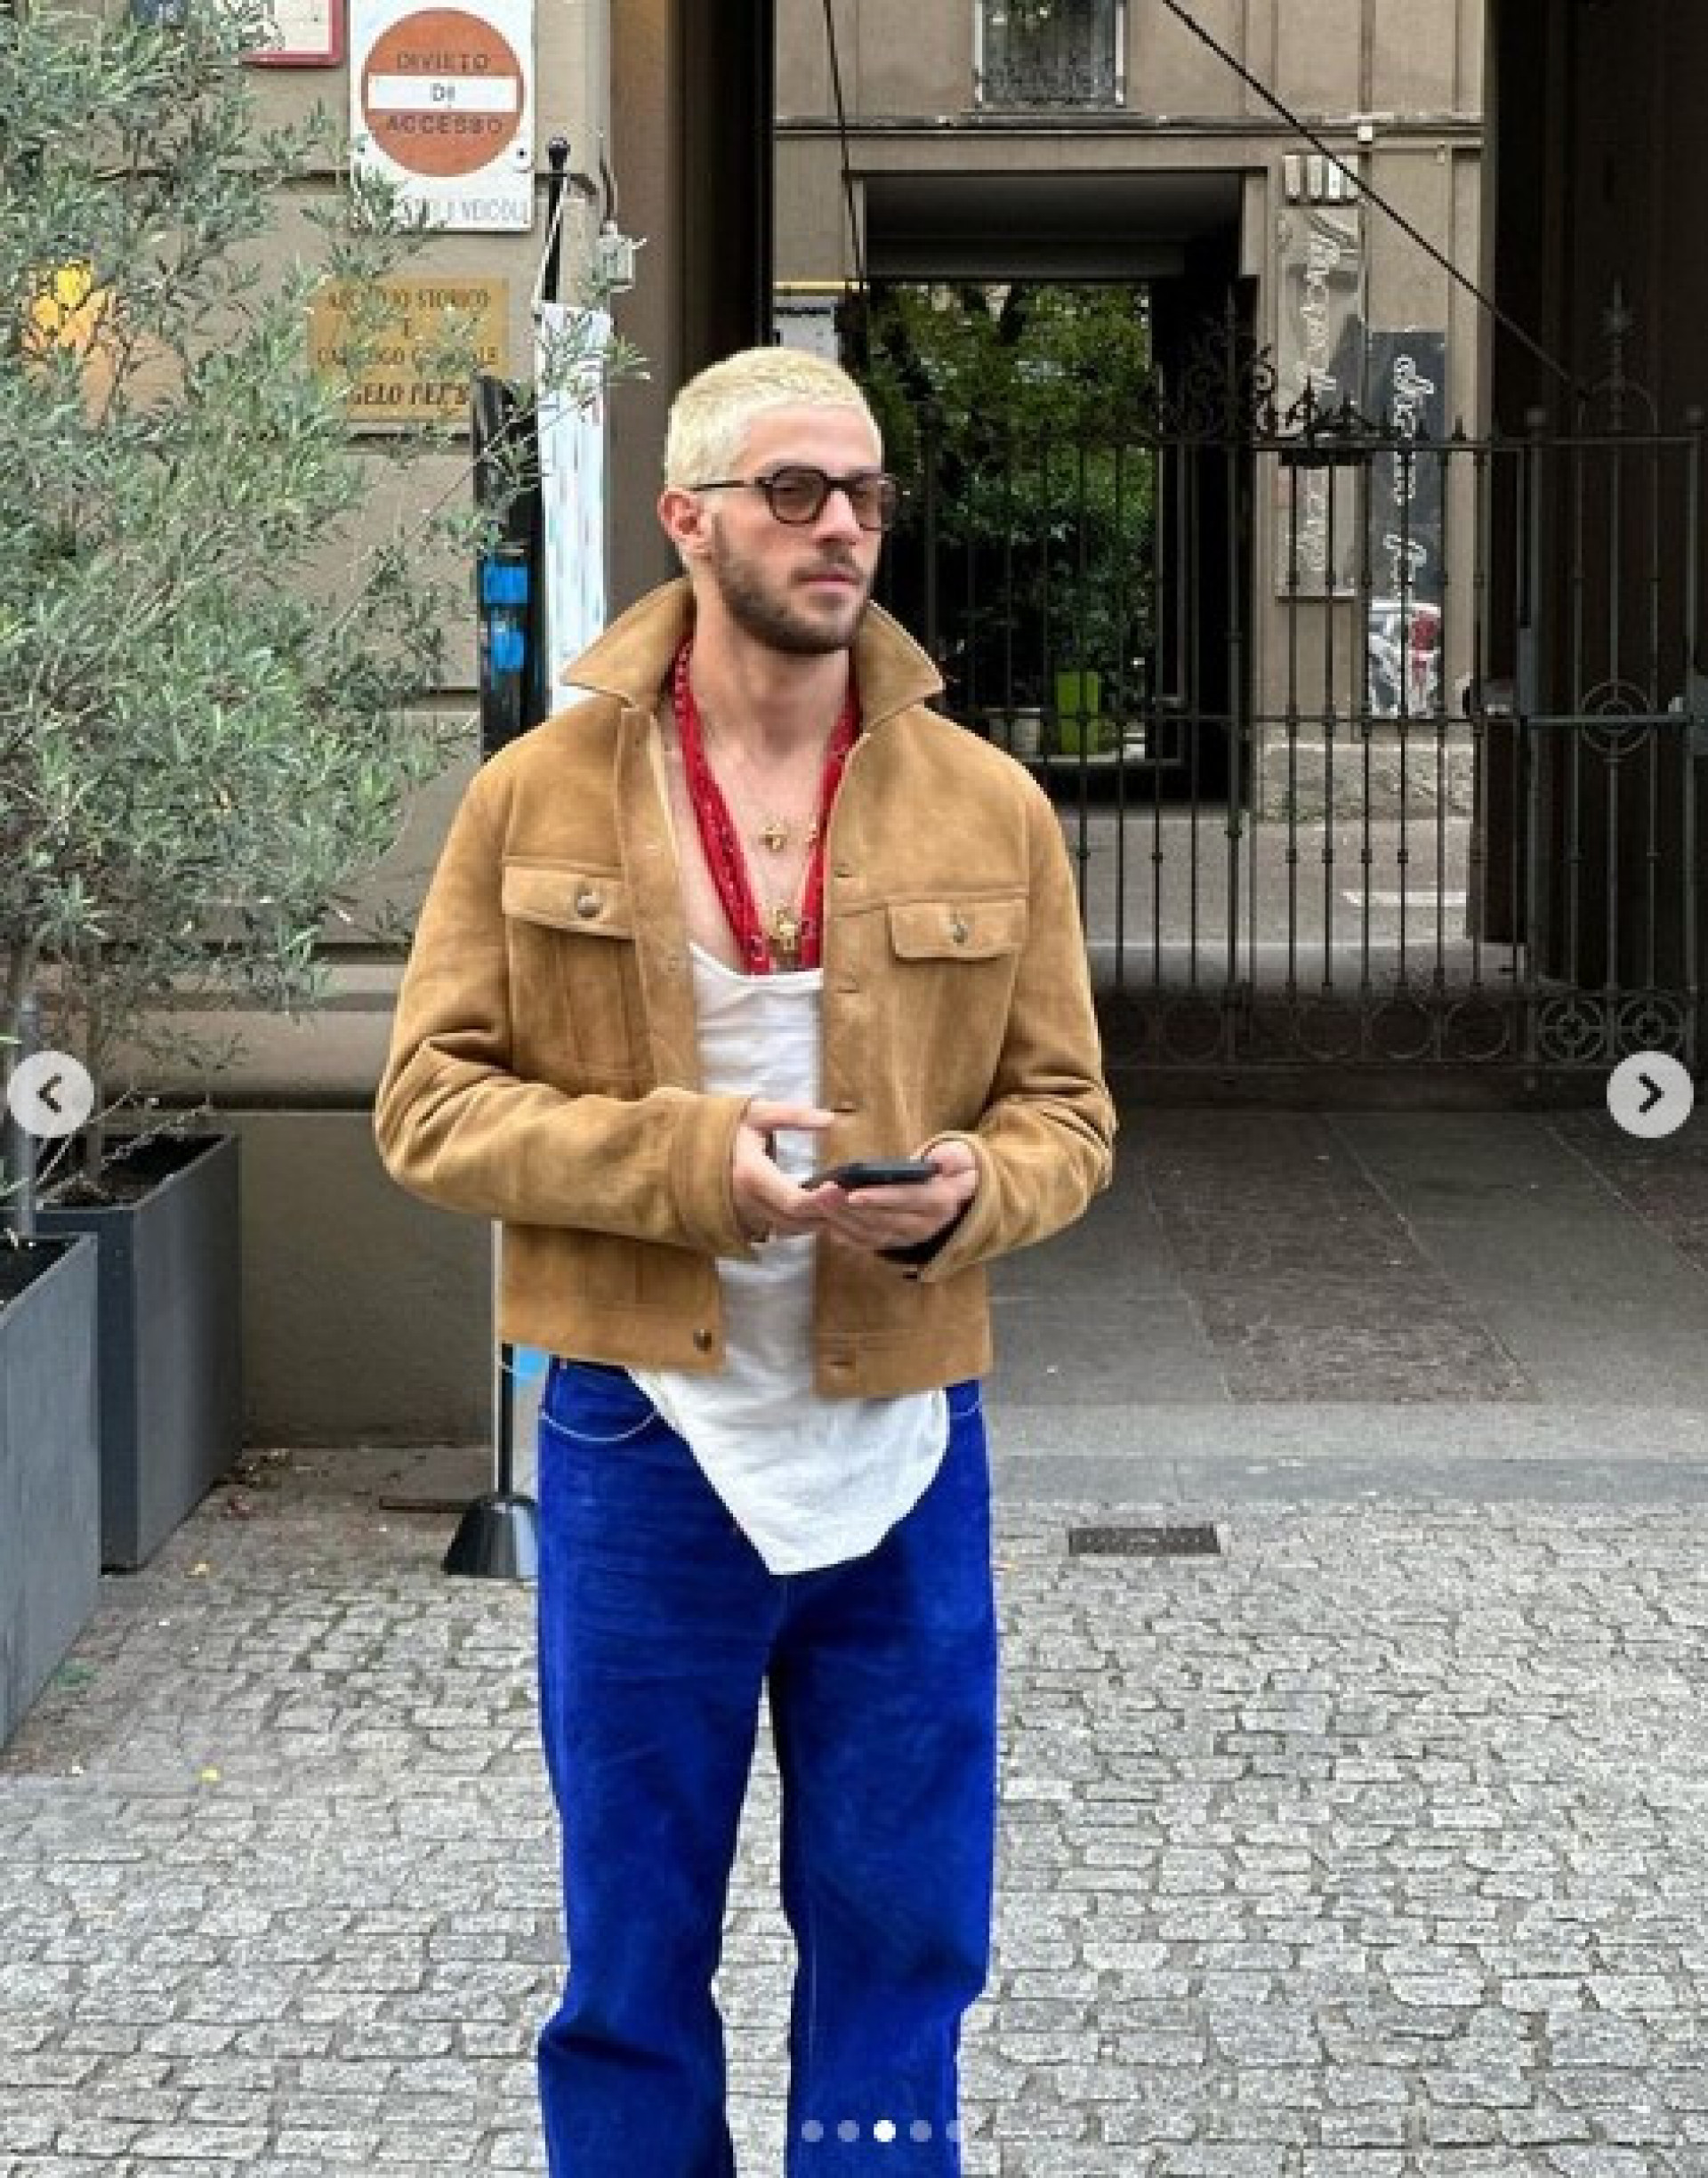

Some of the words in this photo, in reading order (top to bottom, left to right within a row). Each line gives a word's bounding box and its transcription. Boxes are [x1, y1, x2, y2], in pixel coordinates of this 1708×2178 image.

[397, 52, 489, 69] DIVIETO
[431, 83, 455, 101] DI
[386, 115, 503, 134] ACCESSO
